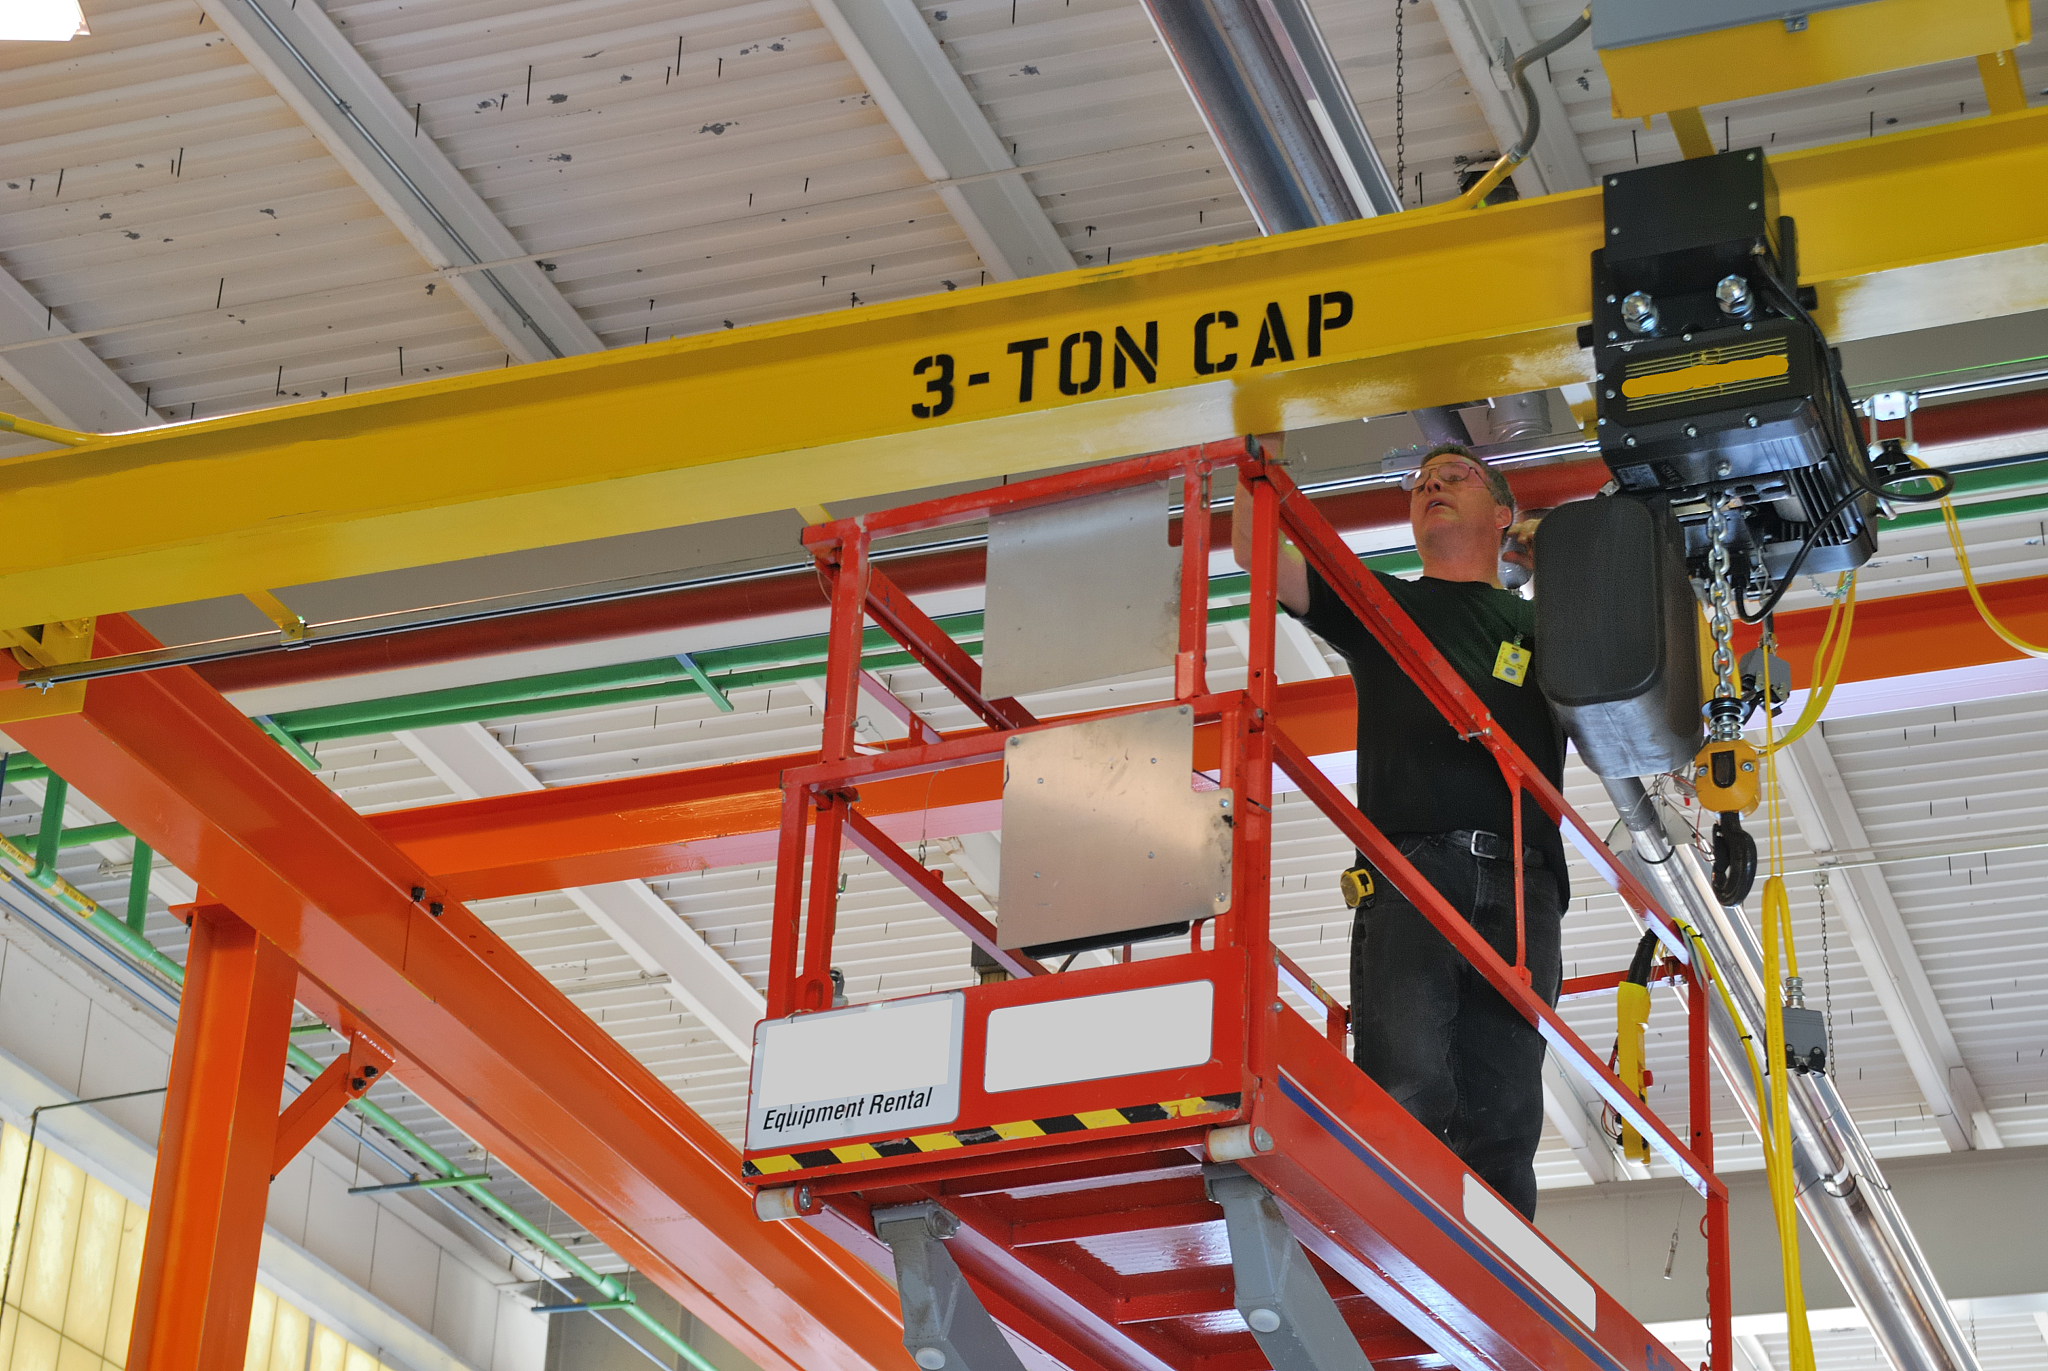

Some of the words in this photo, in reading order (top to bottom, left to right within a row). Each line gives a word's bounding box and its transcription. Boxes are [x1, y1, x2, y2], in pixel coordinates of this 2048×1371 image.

[1194, 290, 1354, 376] CAP
[763, 1097, 865, 1133] Equipment
[868, 1087, 934, 1115] Rental
